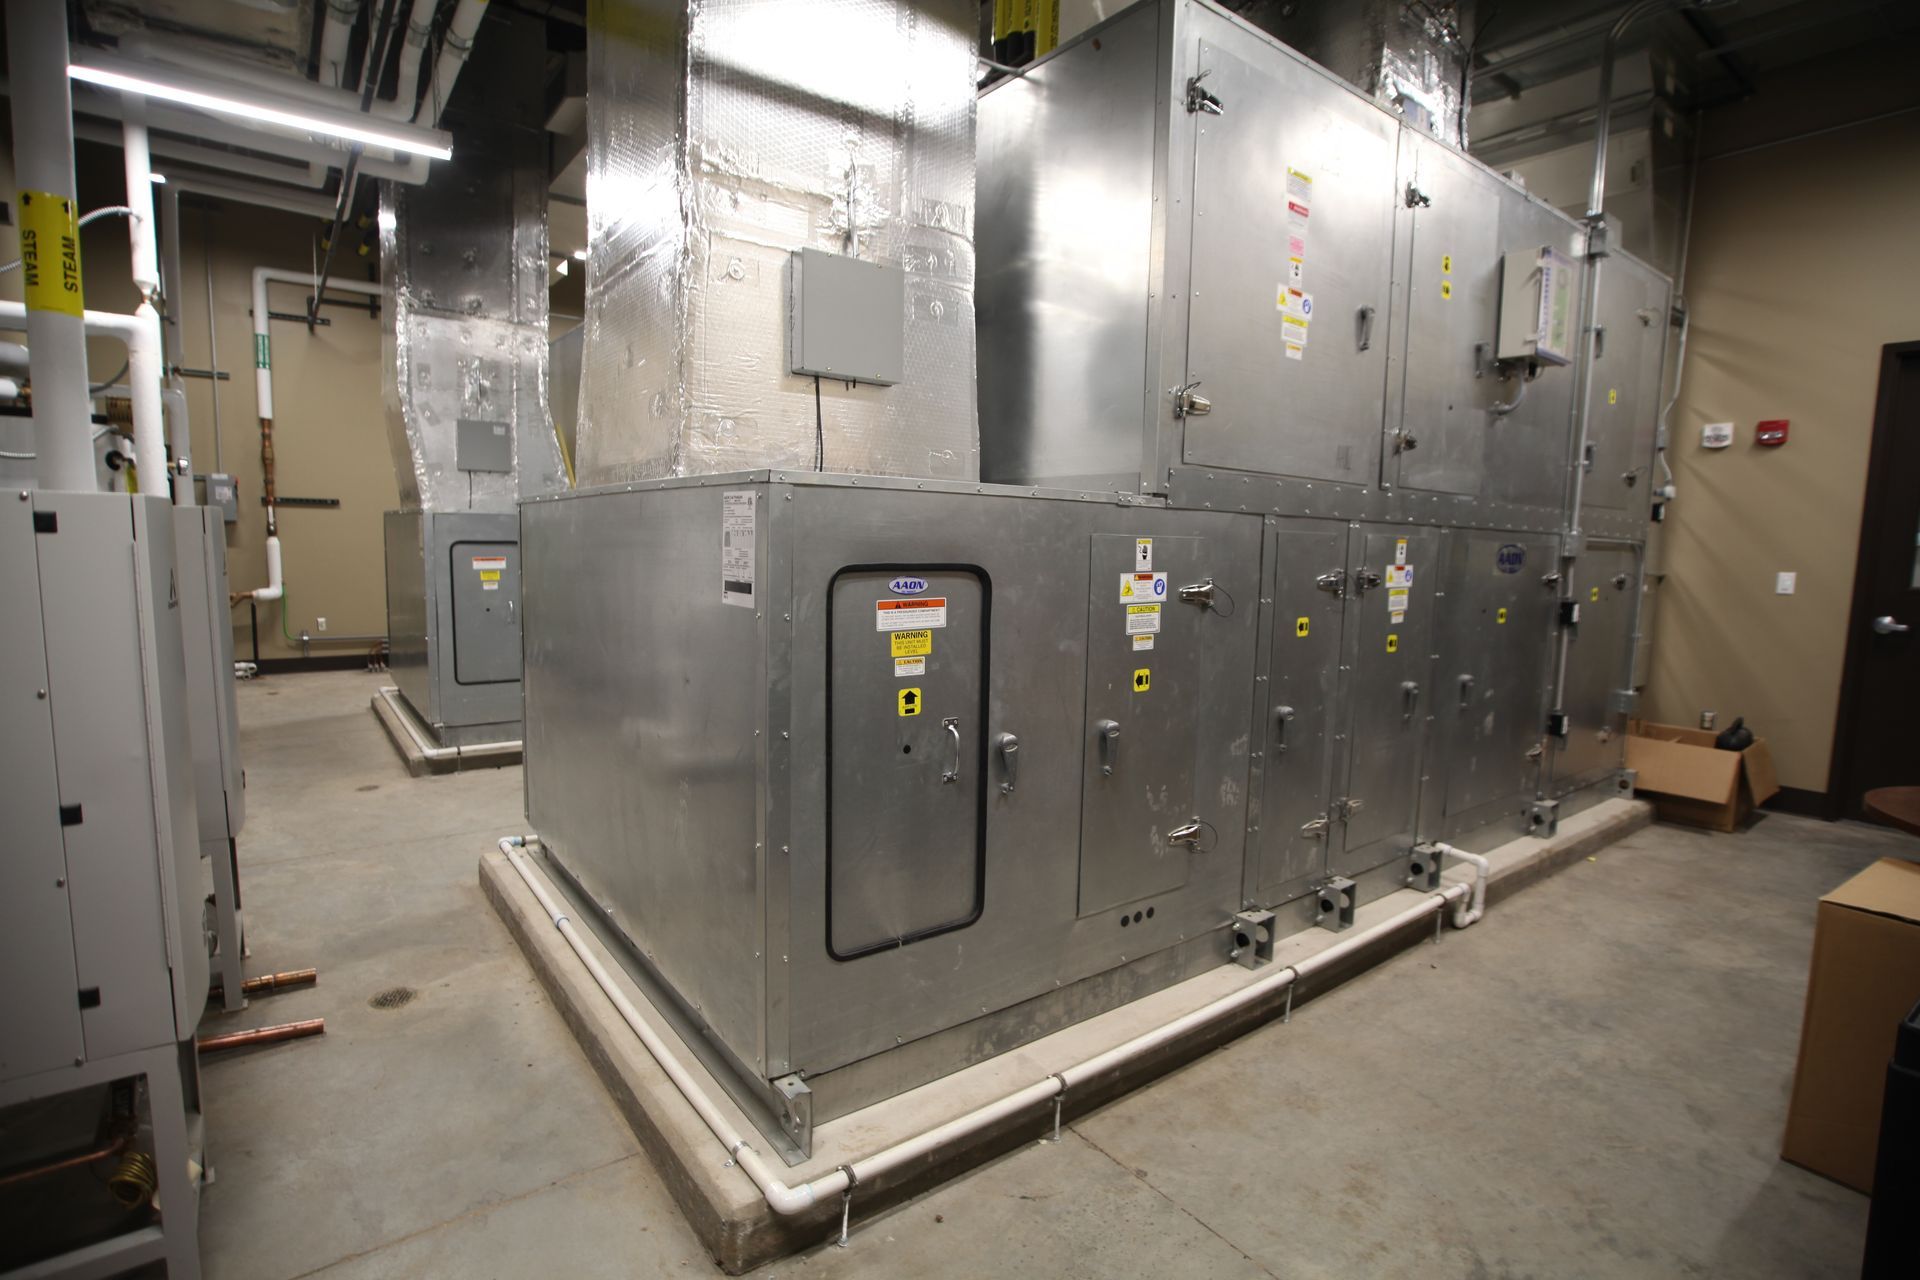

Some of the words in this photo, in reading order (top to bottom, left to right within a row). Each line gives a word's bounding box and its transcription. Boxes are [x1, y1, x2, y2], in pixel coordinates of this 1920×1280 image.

[22, 229, 39, 286] STEAM
[61, 235, 78, 293] STEAM
[892, 581, 925, 590] AAON
[902, 600, 929, 608] WARNING
[895, 631, 928, 640] WARNING
